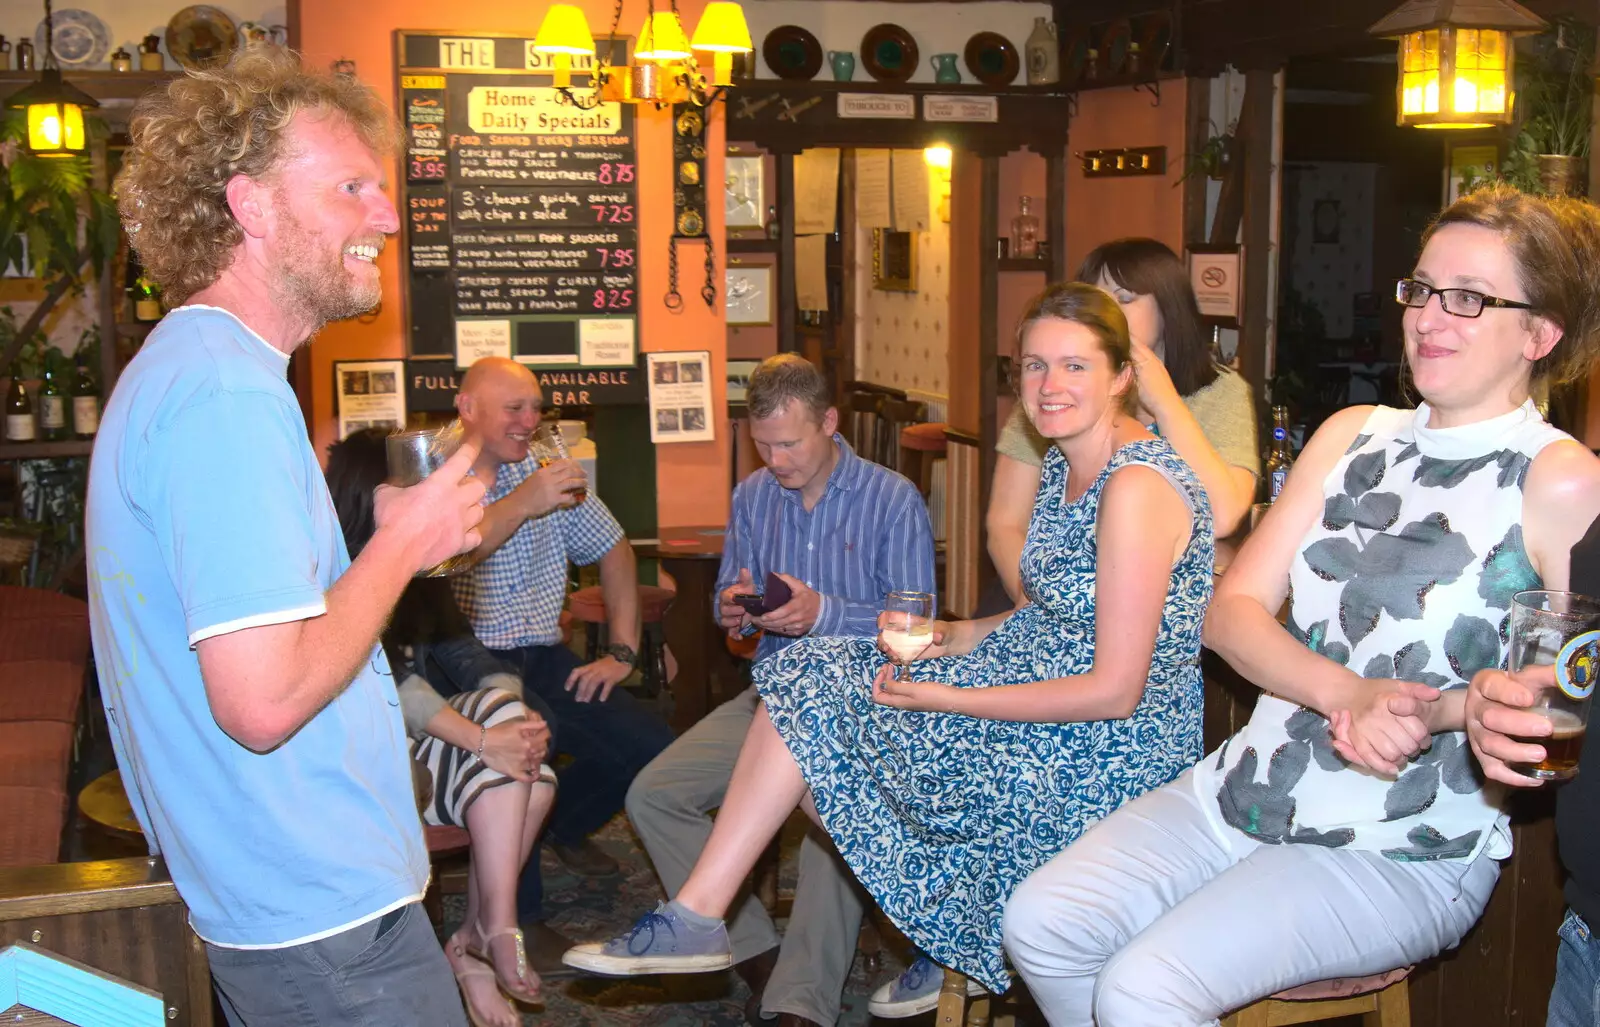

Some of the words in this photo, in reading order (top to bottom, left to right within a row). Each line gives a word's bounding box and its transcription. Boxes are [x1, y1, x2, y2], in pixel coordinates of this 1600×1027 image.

[442, 41, 491, 66] THE
[529, 44, 593, 68] SN
[485, 91, 536, 106] Home
[482, 112, 529, 130] Daily
[538, 112, 610, 130] Specials
[577, 135, 629, 147] SESSION
[460, 167, 517, 179] POTATOES
[532, 170, 597, 182] VEGETABLES
[410, 198, 446, 208] SOUP
[587, 192, 628, 204] served
[412, 212, 427, 221] OF
[429, 212, 448, 221] THE
[415, 223, 440, 233] DAY
[569, 233, 619, 244] SAUSAGES
[556, 276, 598, 286] CURRY
[510, 288, 547, 297] SERVED
[414, 375, 458, 390] FULL
[540, 371, 629, 386] AVAILABLE
[552, 391, 591, 406] BAR
